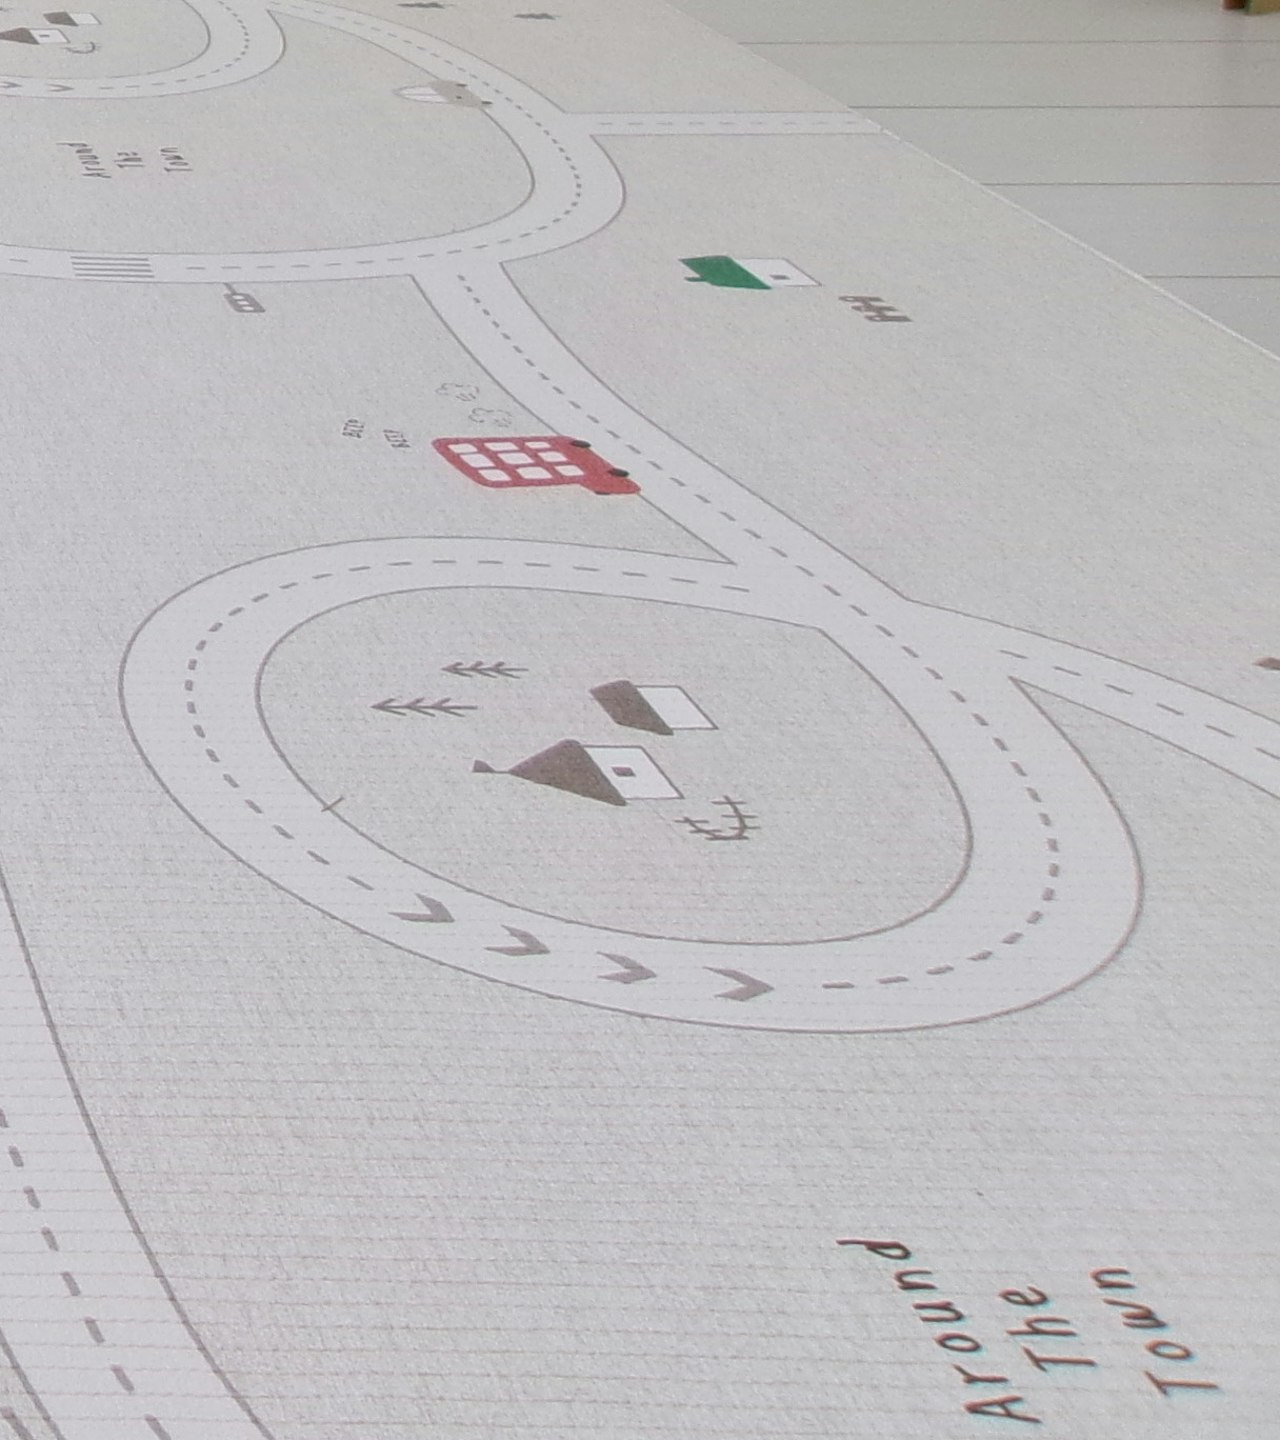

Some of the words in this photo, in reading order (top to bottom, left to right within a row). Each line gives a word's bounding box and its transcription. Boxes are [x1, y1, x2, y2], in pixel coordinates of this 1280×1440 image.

[159, 146, 194, 172] Town
[835, 1237, 1043, 1425] Around
[997, 1284, 1098, 1373] The
[1088, 1266, 1222, 1398] Town
